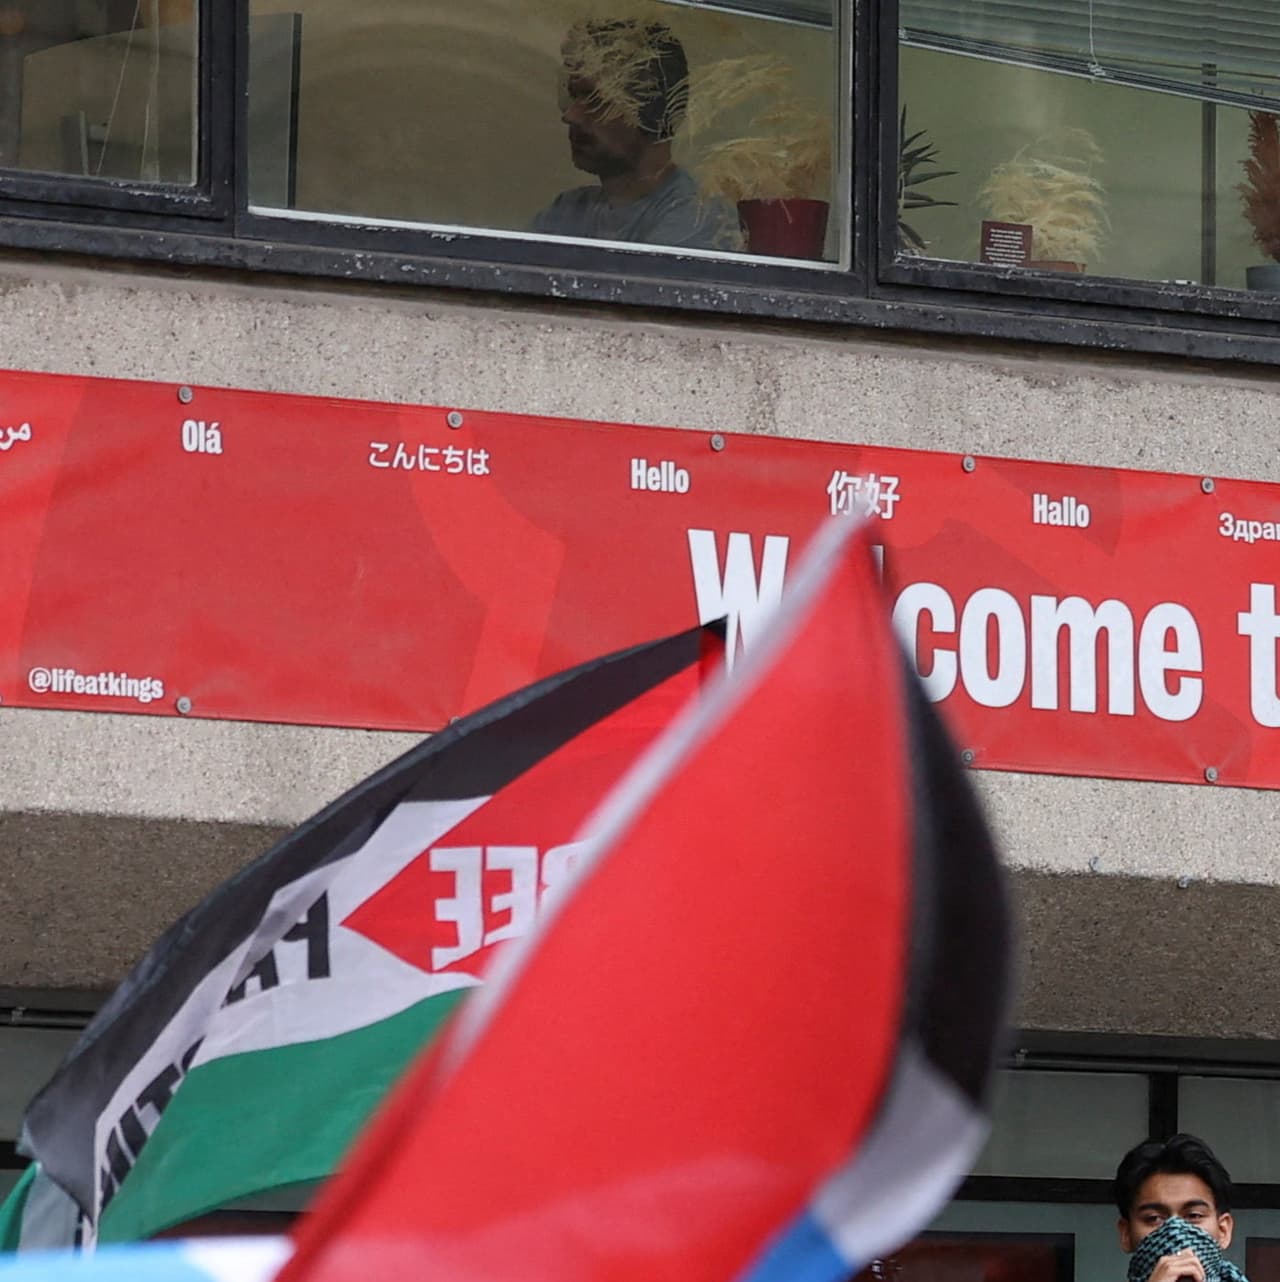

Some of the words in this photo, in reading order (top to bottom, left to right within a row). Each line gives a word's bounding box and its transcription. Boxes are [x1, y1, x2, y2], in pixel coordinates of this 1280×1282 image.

[182, 419, 223, 454] Olá
[368, 441, 491, 476] こんにちは
[630, 458, 690, 493] Hello
[826, 470, 901, 519] 你好
[1033, 493, 1090, 528] Hallo
[687, 528, 1204, 723] Wcome
[28, 666, 164, 703] @lifeatkings
